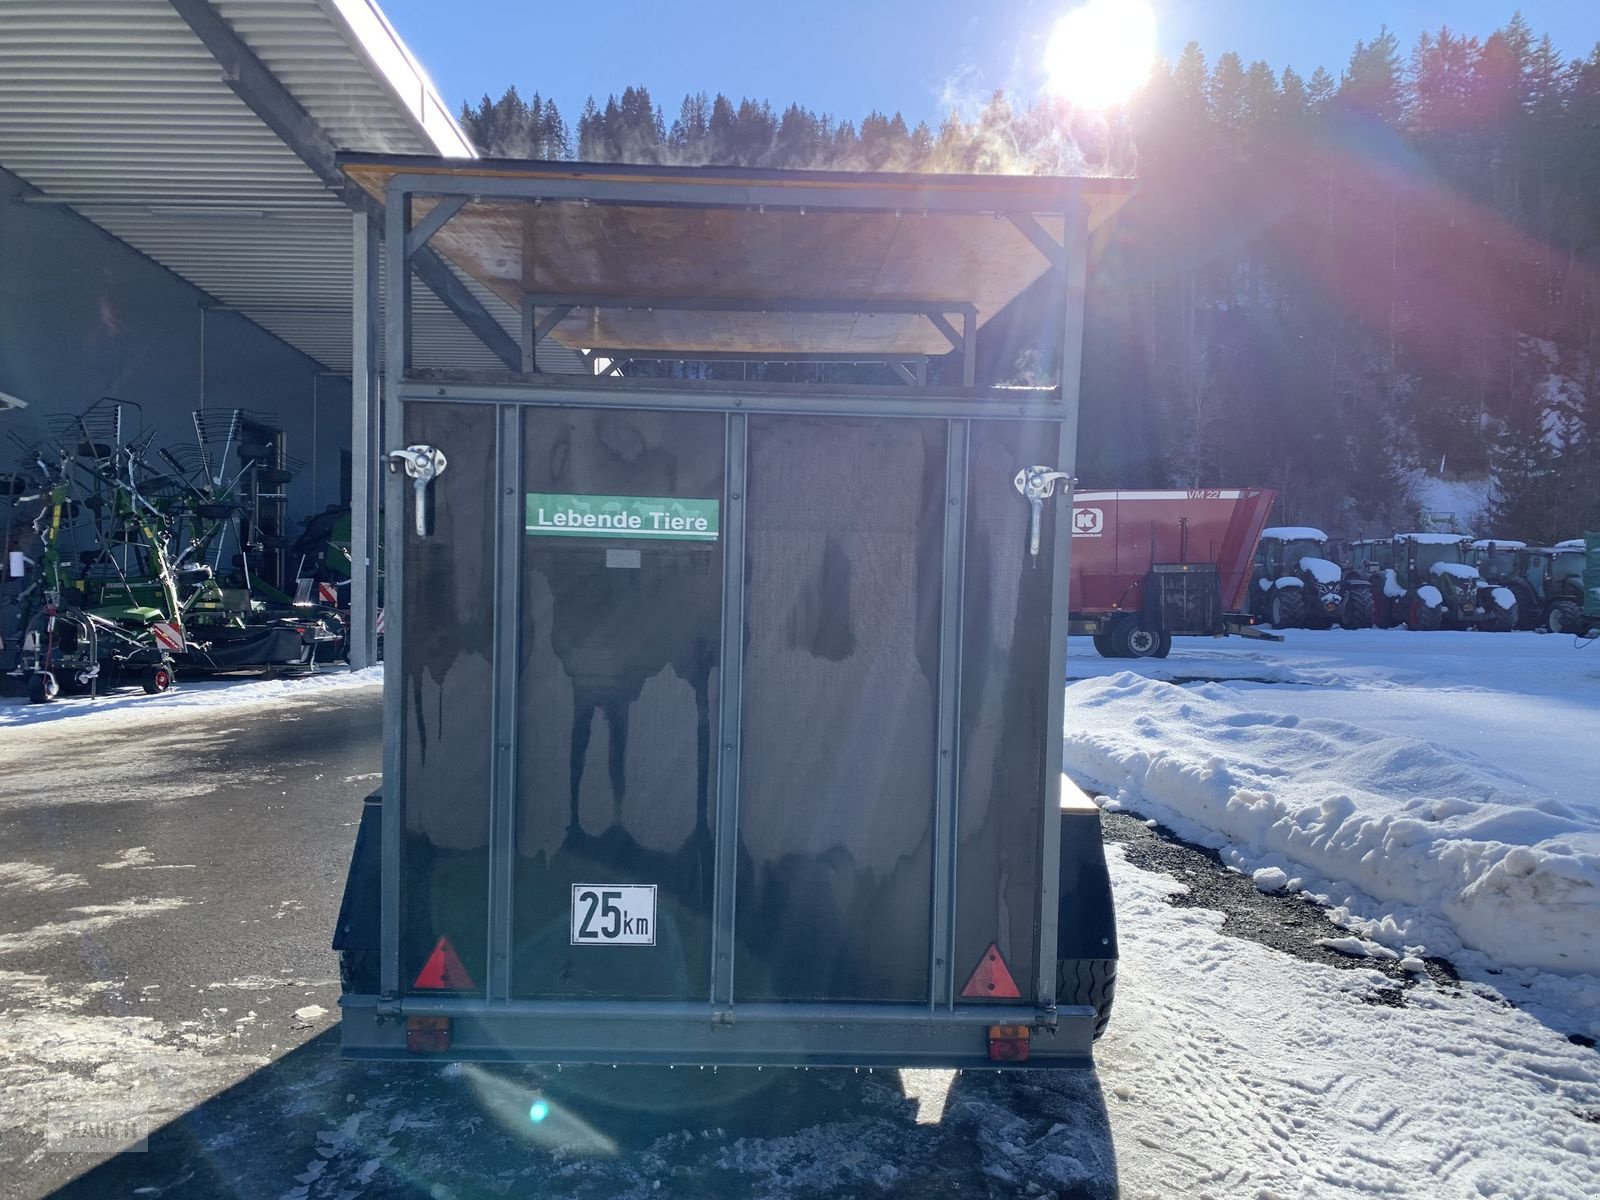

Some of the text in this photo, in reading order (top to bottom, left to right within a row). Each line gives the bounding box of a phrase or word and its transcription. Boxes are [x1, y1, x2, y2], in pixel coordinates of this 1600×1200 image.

[1188, 490, 1219, 500] VM 22
[538, 508, 708, 531] Lebende Tiere
[1076, 513, 1094, 528] K
